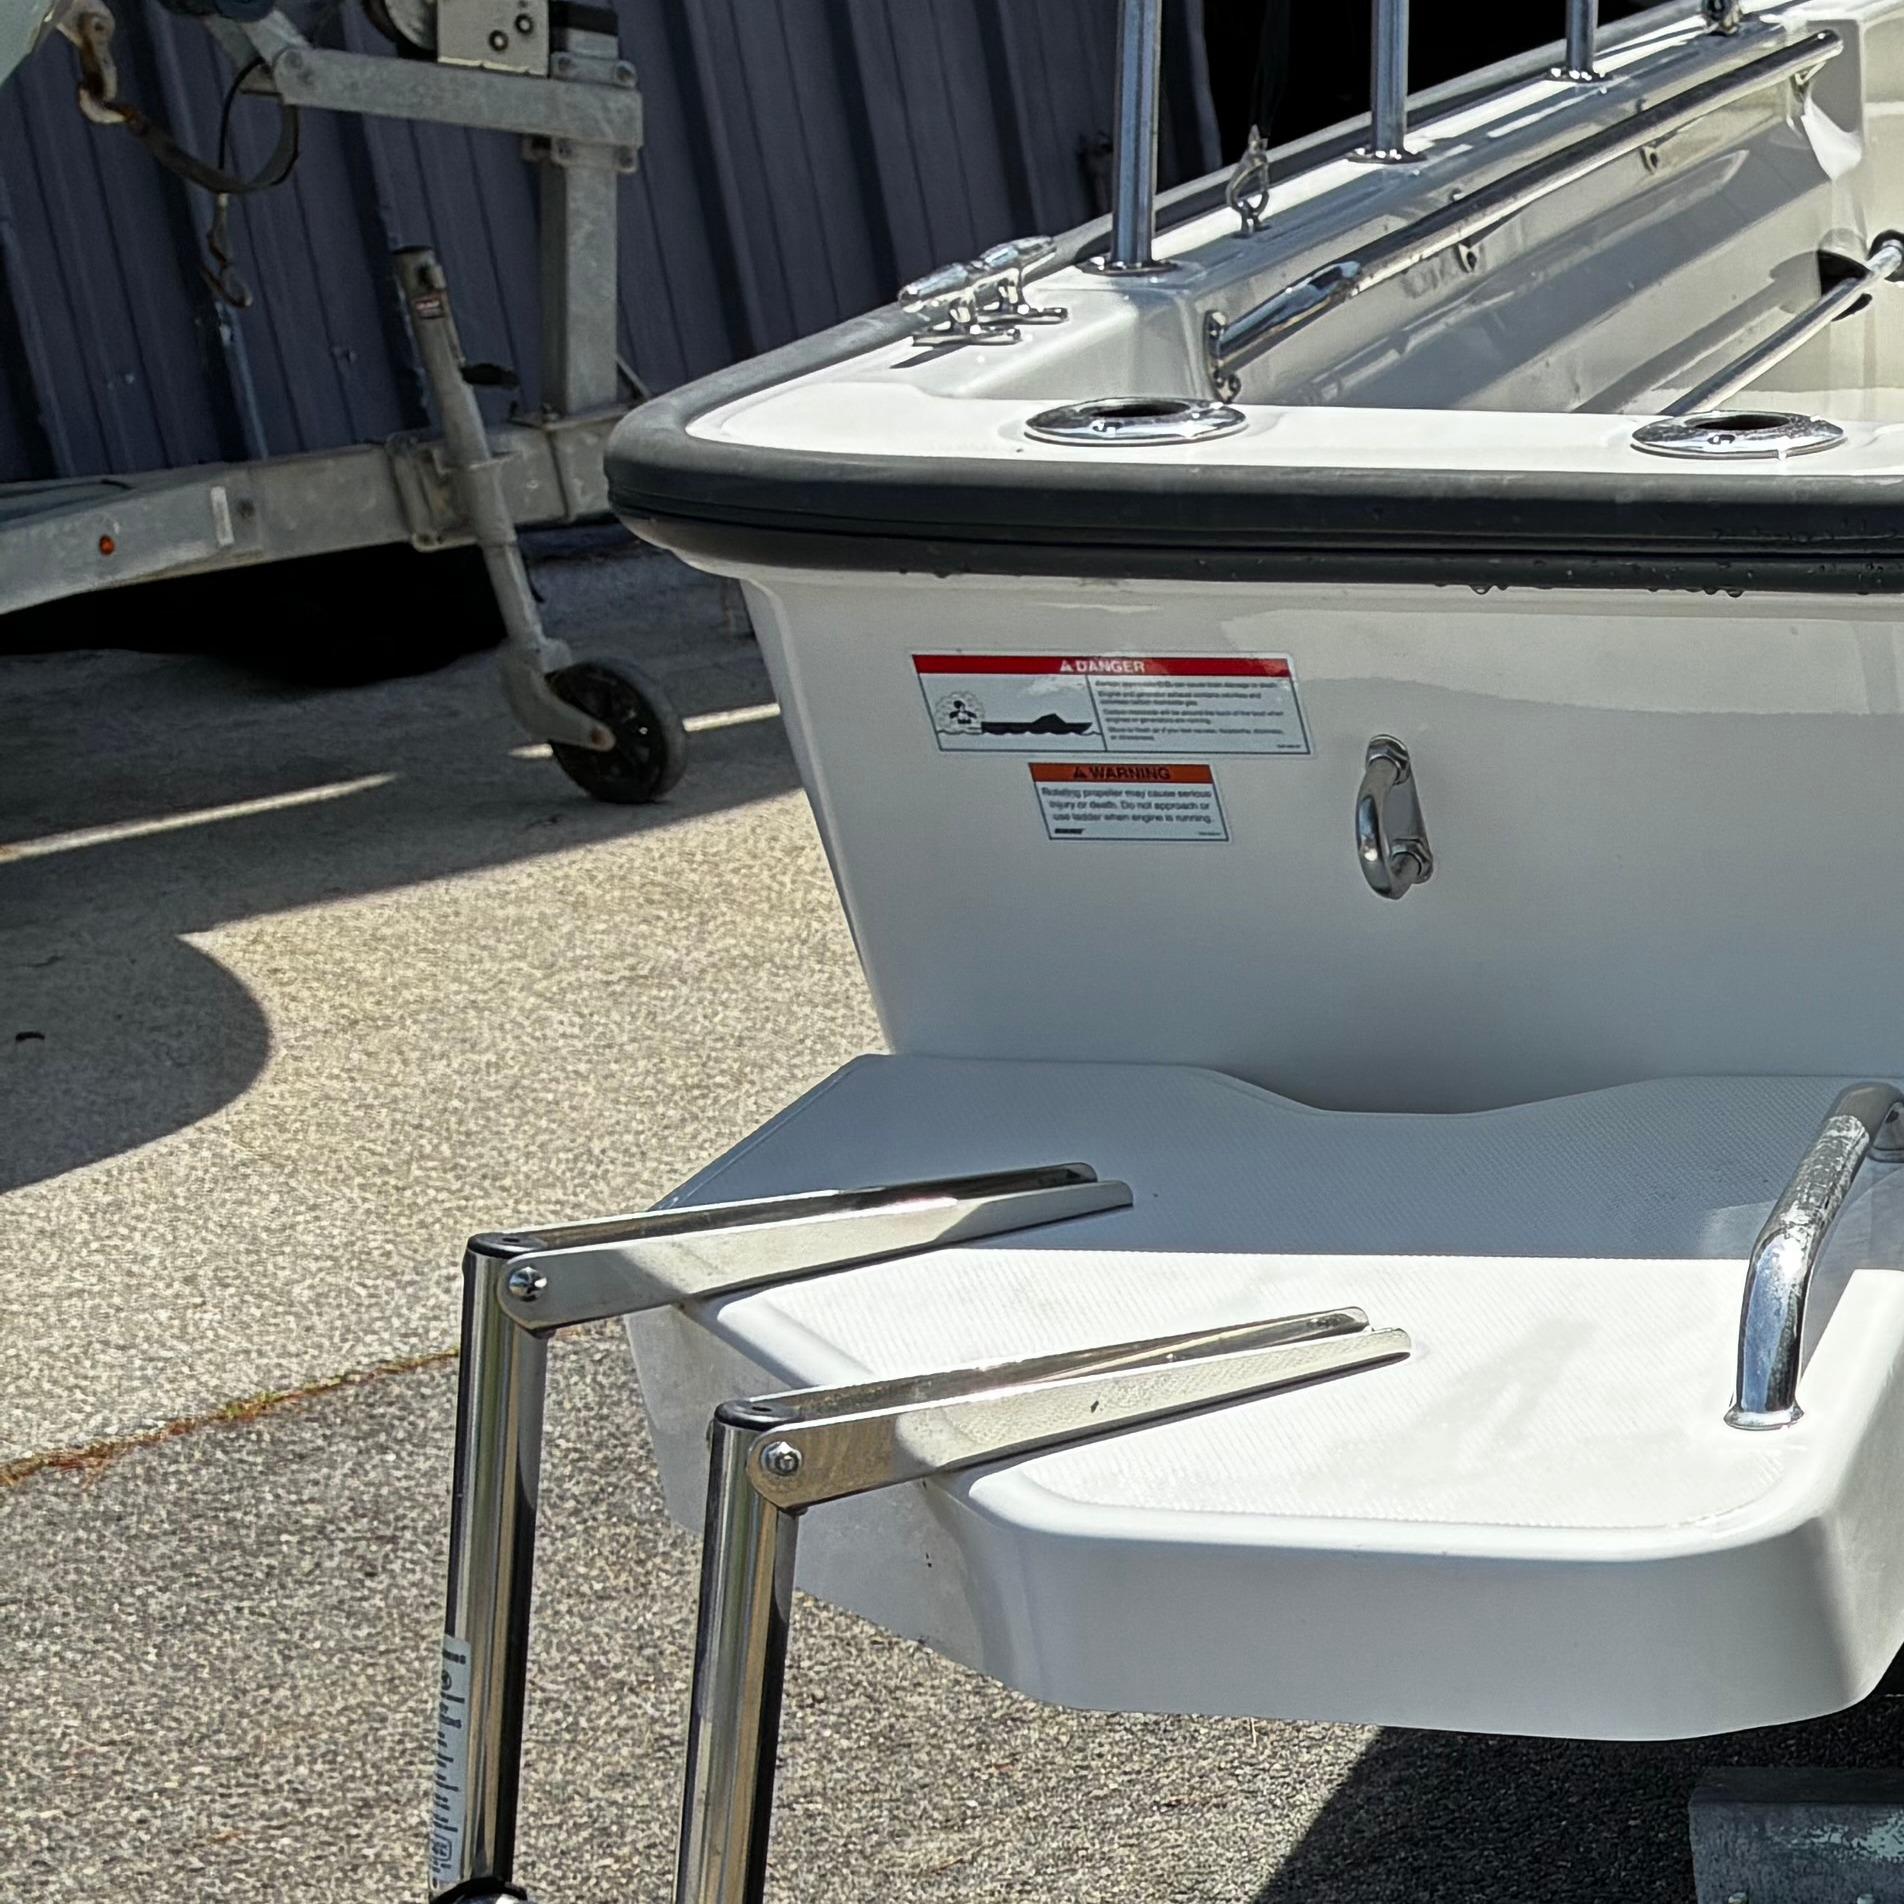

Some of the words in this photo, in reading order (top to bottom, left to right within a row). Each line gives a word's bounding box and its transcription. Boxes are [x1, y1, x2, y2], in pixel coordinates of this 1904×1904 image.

[1076, 659, 1146, 674] DANGER
[1090, 767, 1171, 779] WARNING
[1125, 790, 1145, 799] may
[1121, 801, 1135, 810] Do
[1155, 802, 1199, 811] approach
[1132, 814, 1163, 823] engine
